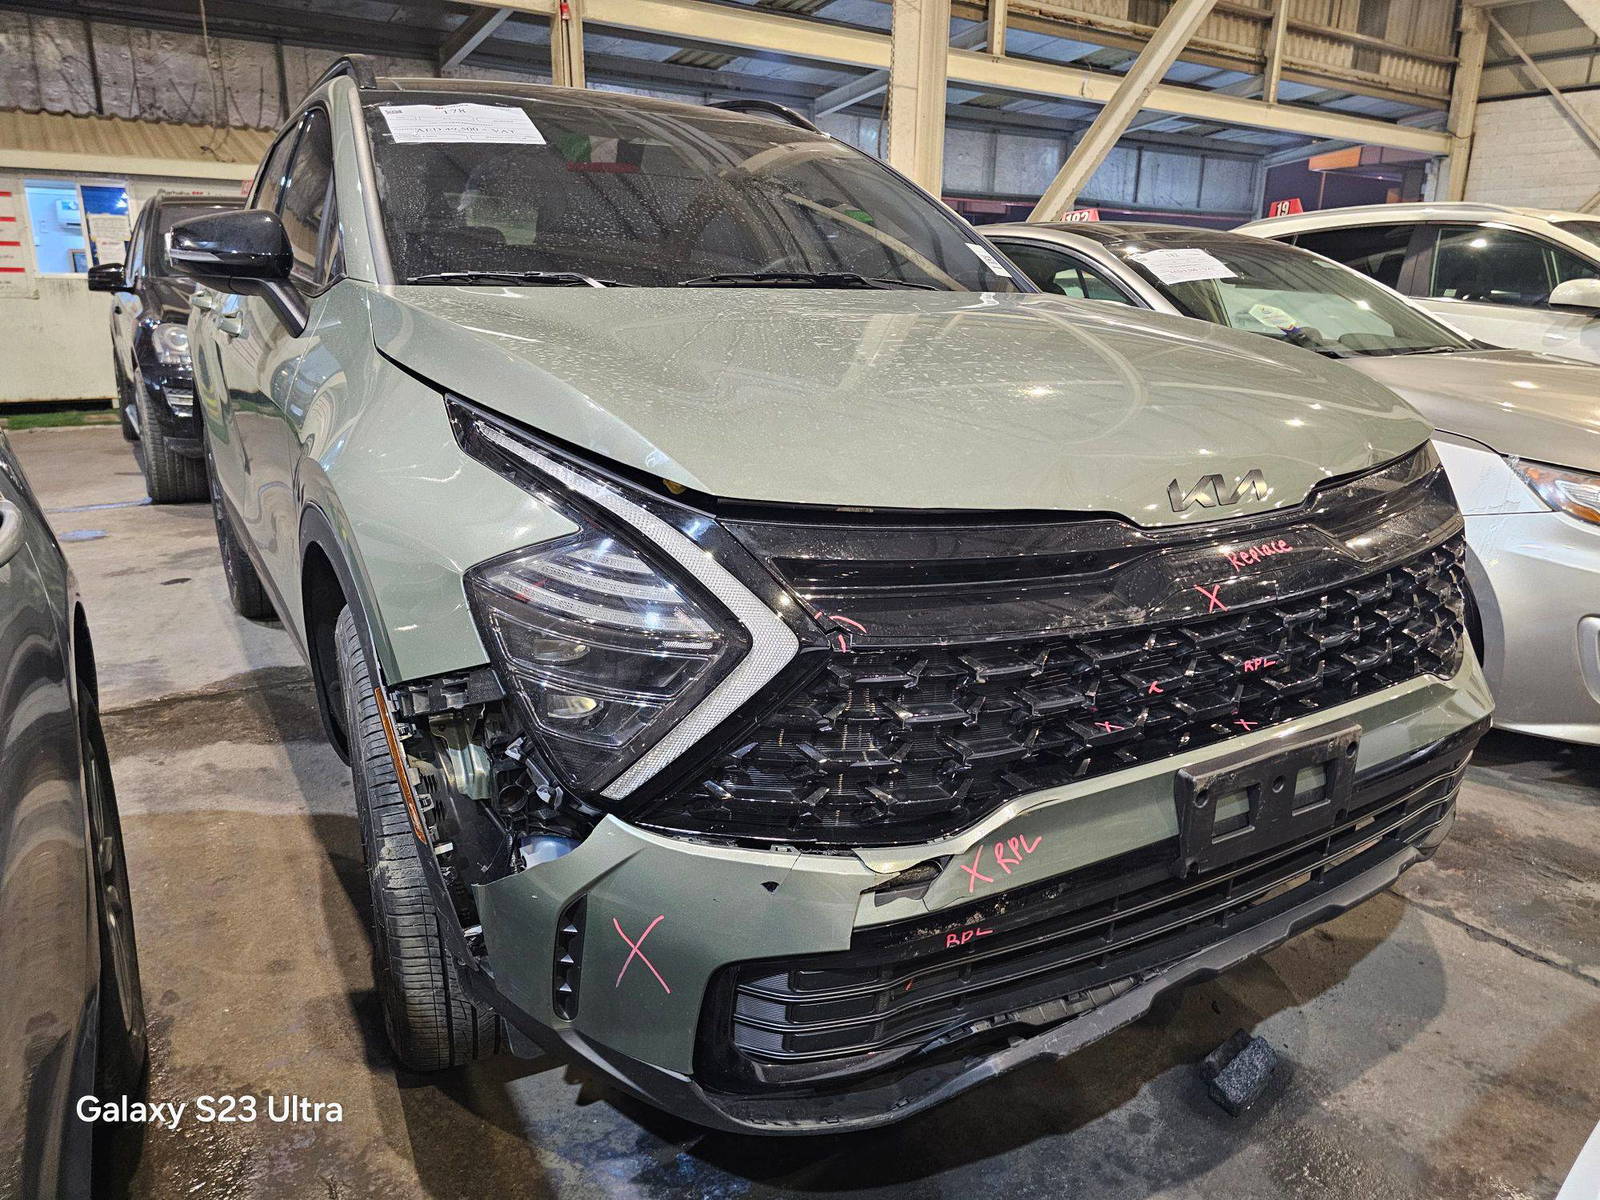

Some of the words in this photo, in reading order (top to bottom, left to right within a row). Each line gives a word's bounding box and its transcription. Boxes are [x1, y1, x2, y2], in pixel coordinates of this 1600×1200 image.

[1167, 468, 1267, 512] KIA
[1243, 658, 1277, 672] RPL
[994, 834, 1042, 875] RPL
